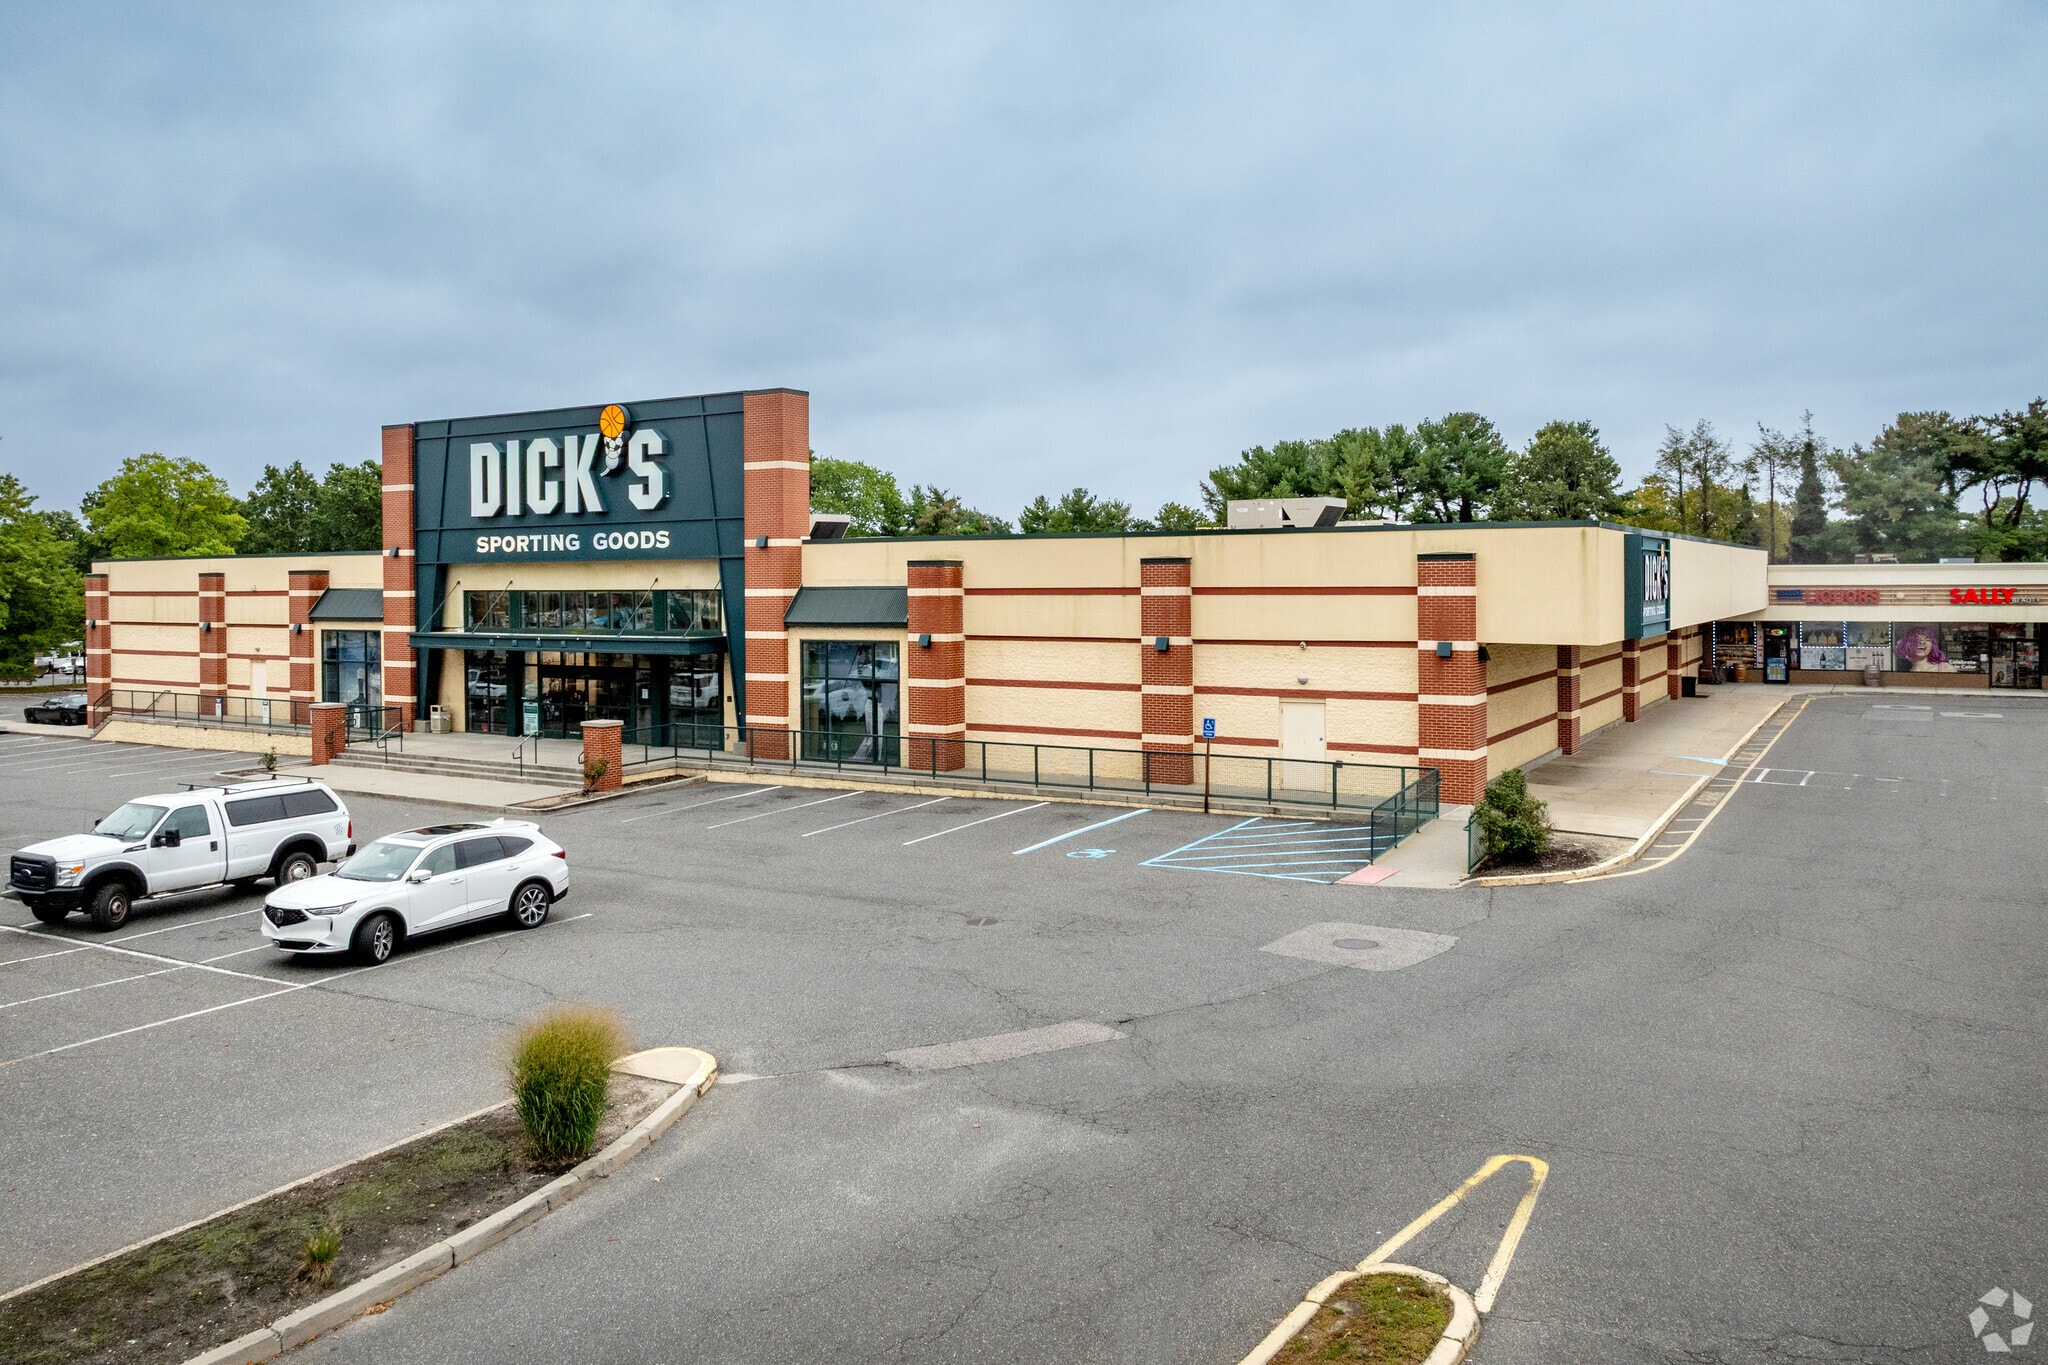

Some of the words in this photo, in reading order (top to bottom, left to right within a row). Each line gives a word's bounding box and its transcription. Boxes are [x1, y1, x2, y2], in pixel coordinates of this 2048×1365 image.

[470, 404, 668, 518] DICK'S
[476, 533, 580, 553] SPORTING
[593, 530, 670, 550] GOODS
[1805, 588, 1880, 605] LIQUORS
[1950, 587, 2016, 605] SALLY
